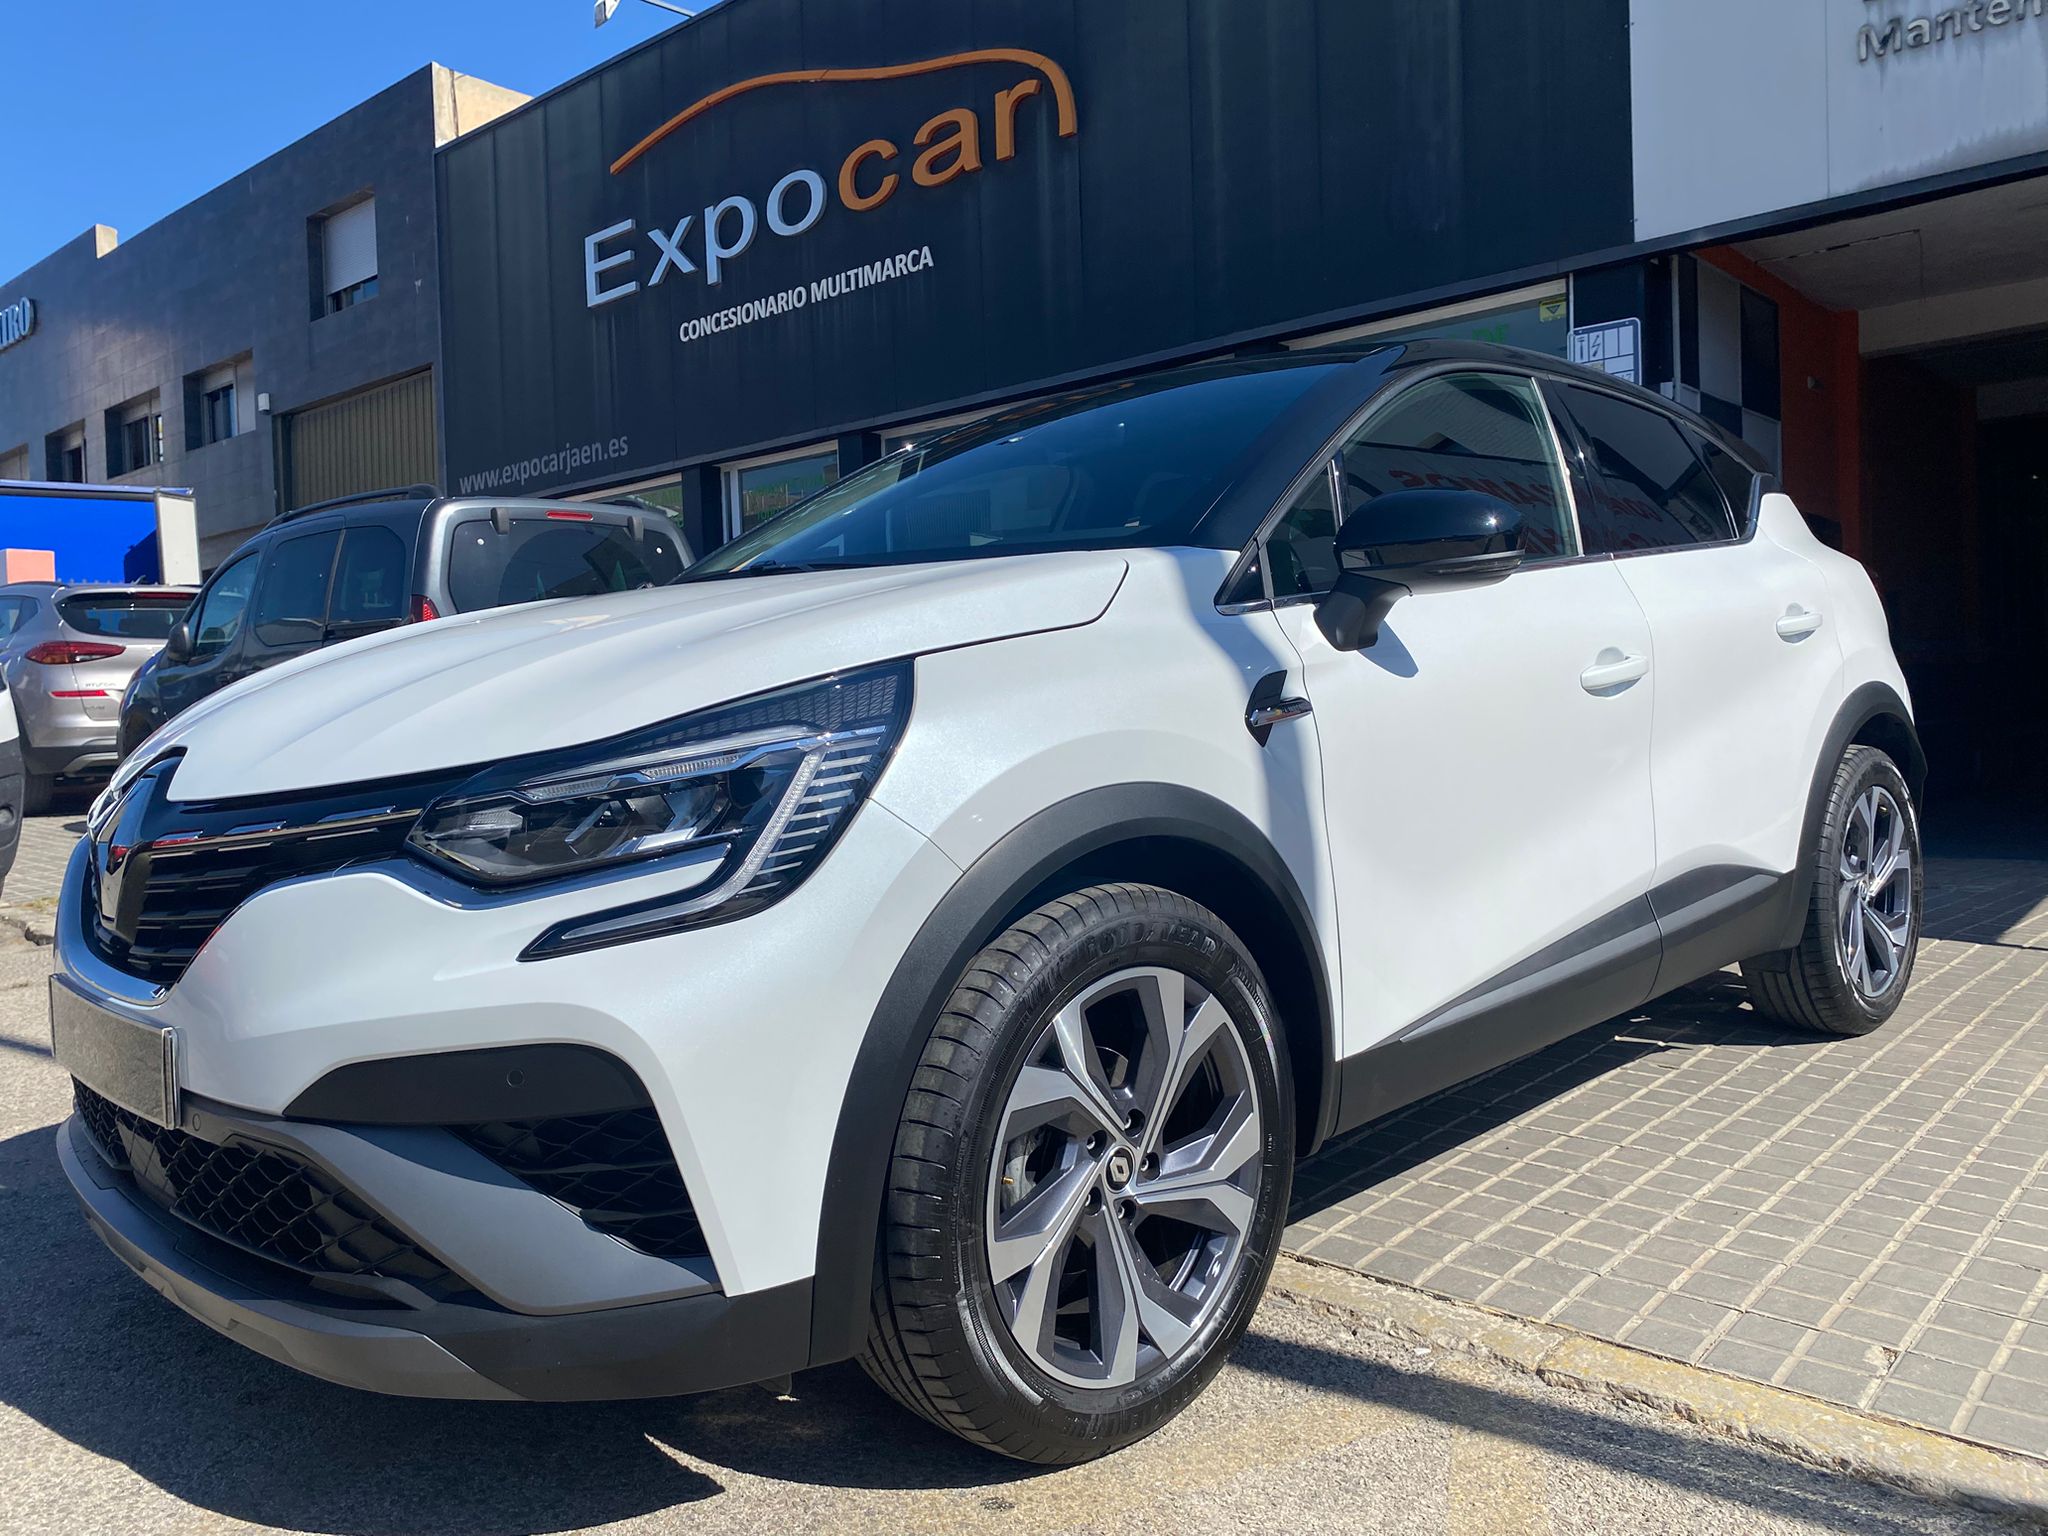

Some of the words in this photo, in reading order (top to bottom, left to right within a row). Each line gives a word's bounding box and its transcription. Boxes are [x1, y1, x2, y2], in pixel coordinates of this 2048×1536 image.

[584, 79, 1042, 308] Expocar
[679, 286, 807, 342] CONCESIONARIO
[810, 245, 934, 304] MULTIMARCA
[459, 435, 629, 495] www.expocarjaen.es
